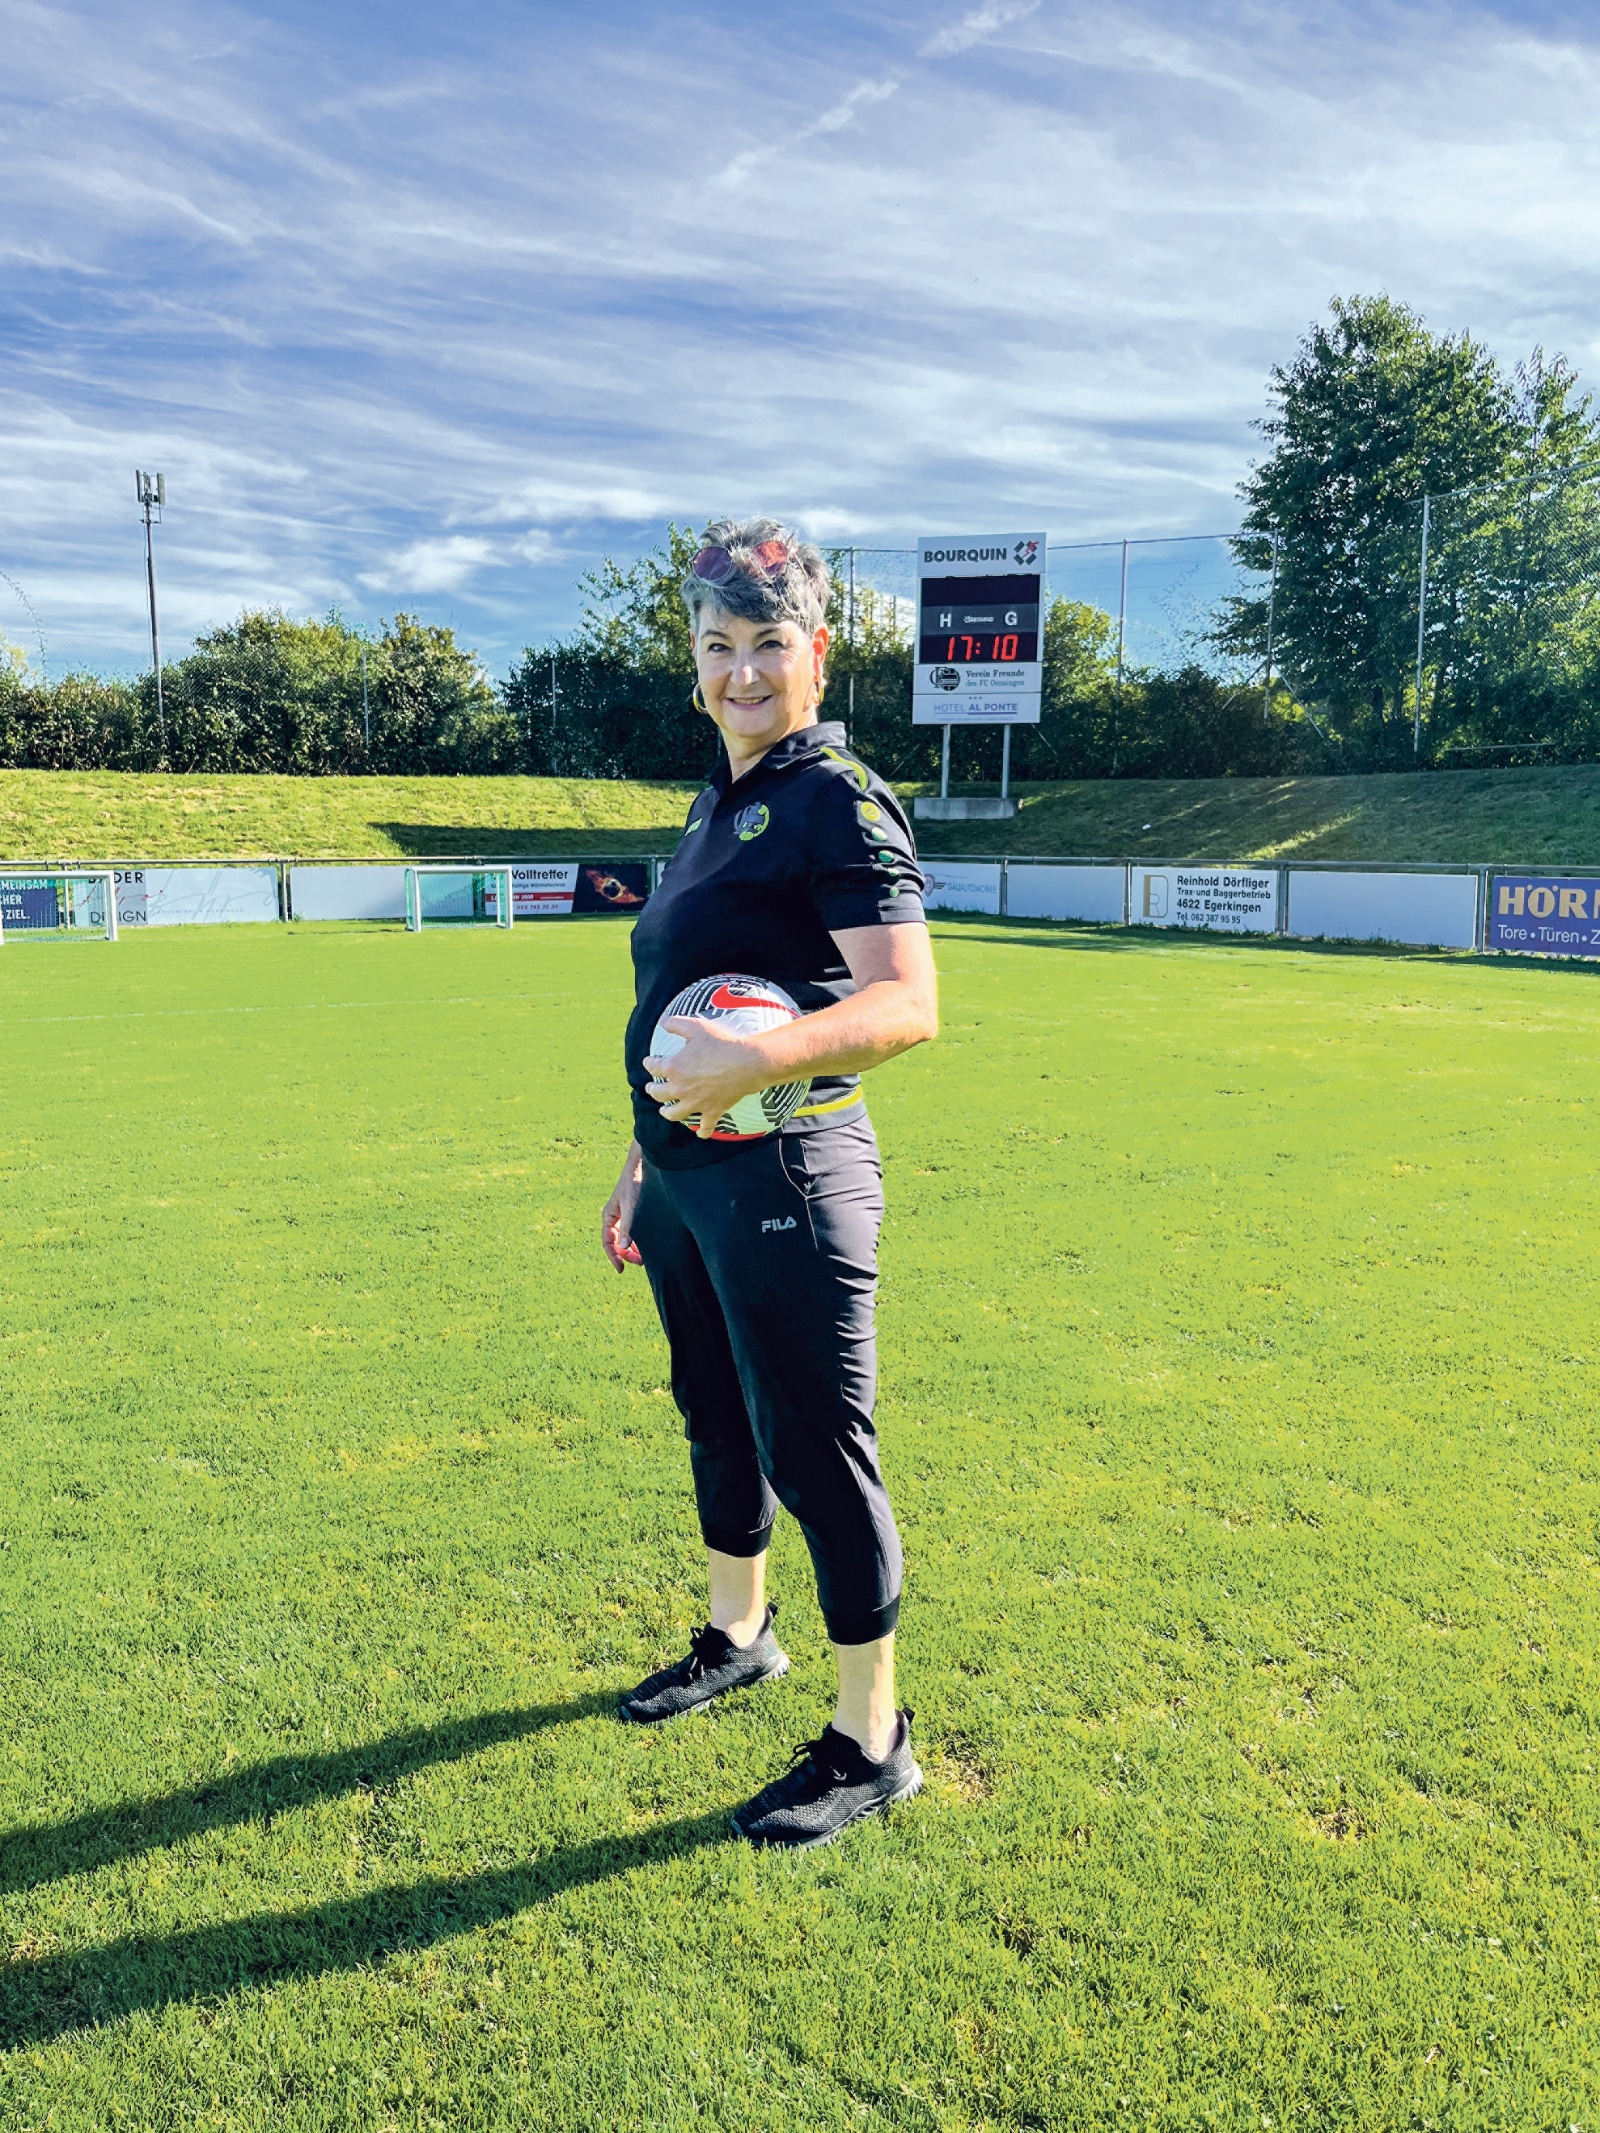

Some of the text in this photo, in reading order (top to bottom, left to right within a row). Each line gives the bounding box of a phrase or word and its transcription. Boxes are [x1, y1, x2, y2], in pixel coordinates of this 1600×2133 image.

[923, 548, 1007, 563] BOURQUIN
[939, 613, 952, 628] H
[1004, 611, 1018, 626] G
[947, 635, 1019, 661] 17:10
[965, 669, 1025, 678] Verein Freunde
[965, 679, 977, 687] des
[979, 679, 989, 687] FC
[934, 703, 1018, 712] HOTEL AL PONTE
[512, 869, 568, 880] Volltreffer
[0, 878, 48, 891] MEINSAM
[1177, 875, 1270, 889] Reinhold Dörfliger
[0, 894, 22, 905] HER
[1213, 888, 1271, 899] Baggerbetrieb
[1177, 898, 1261, 914] 4622 Egerkingen
[91, 910, 147, 924] DIGN
[1191, 913, 1204, 922] 062
[1206, 914, 1219, 923] 387
[1220, 915, 1230, 924] 95
[1231, 915, 1241, 924] 95
[1497, 924, 1528, 940] Tore
[1537, 926, 1579, 943] Türen
[761, 1215, 797, 1233] FILA
